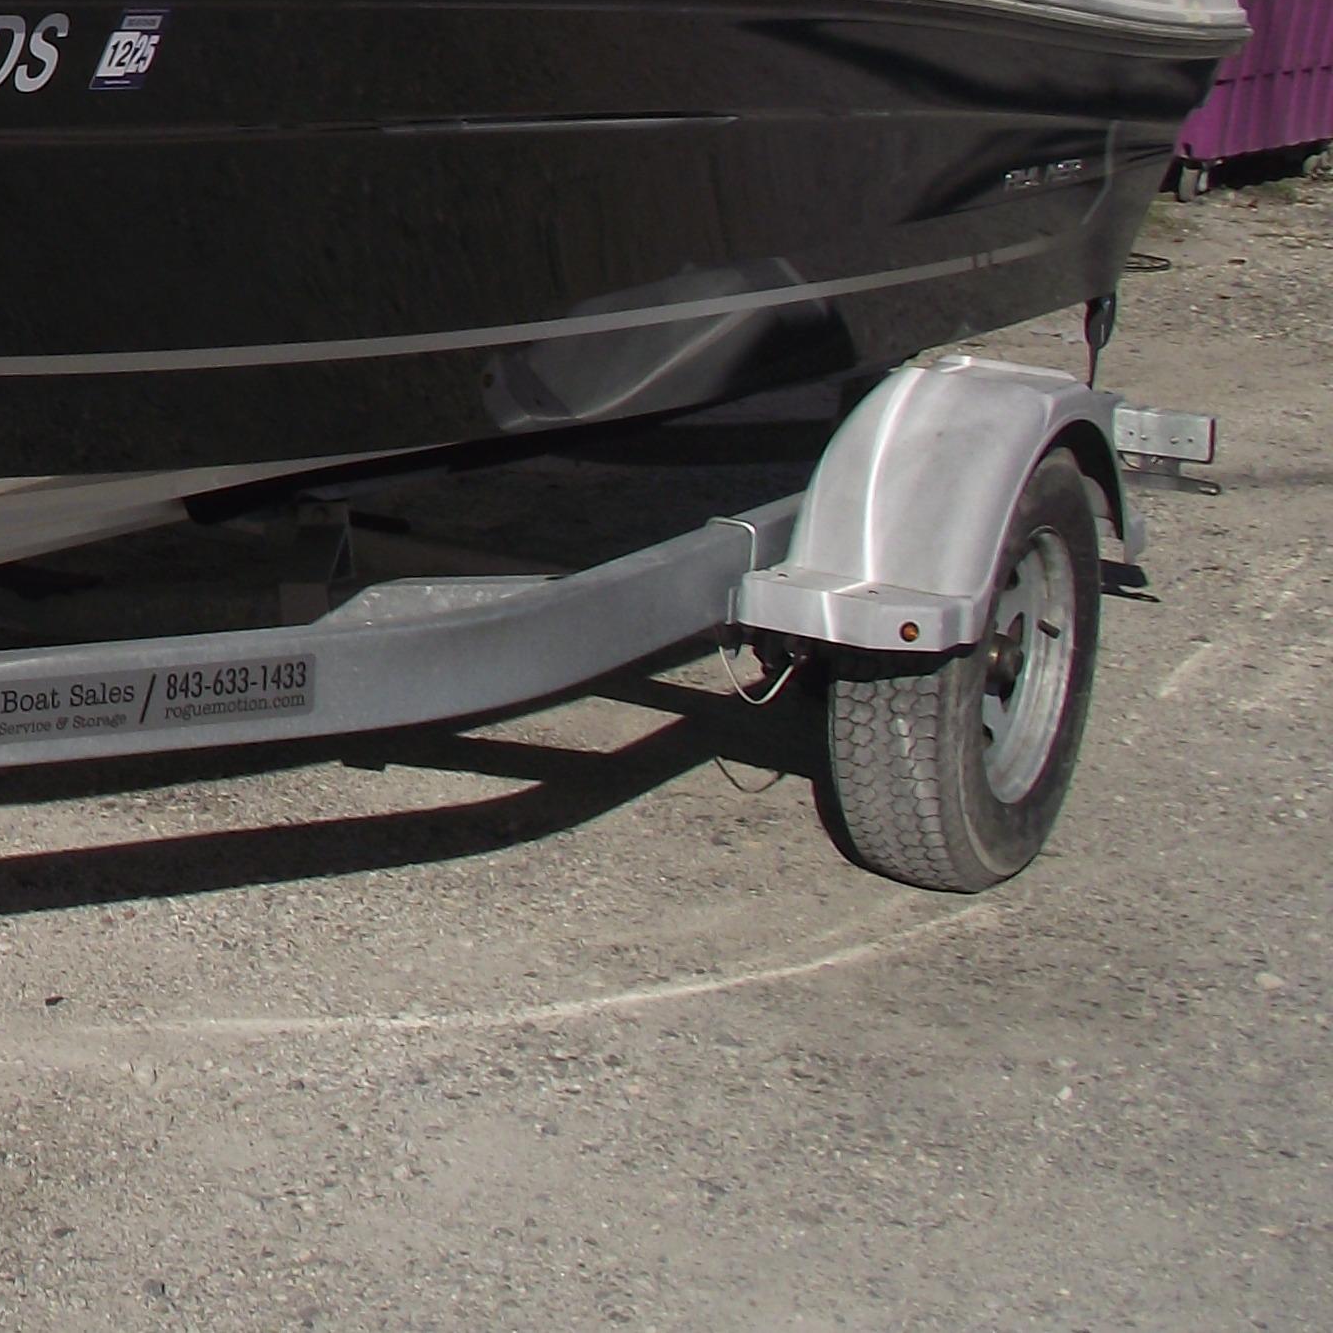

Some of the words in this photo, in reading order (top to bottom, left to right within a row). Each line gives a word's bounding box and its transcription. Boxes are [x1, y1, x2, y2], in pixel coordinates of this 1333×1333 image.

[166, 661, 307, 701] 843-633-1433
[0, 687, 61, 715] Boat
[69, 682, 136, 708] Sales
[165, 693, 306, 721] roguemotion.com
[55, 716, 69, 731] &
[72, 712, 128, 729] Storage
